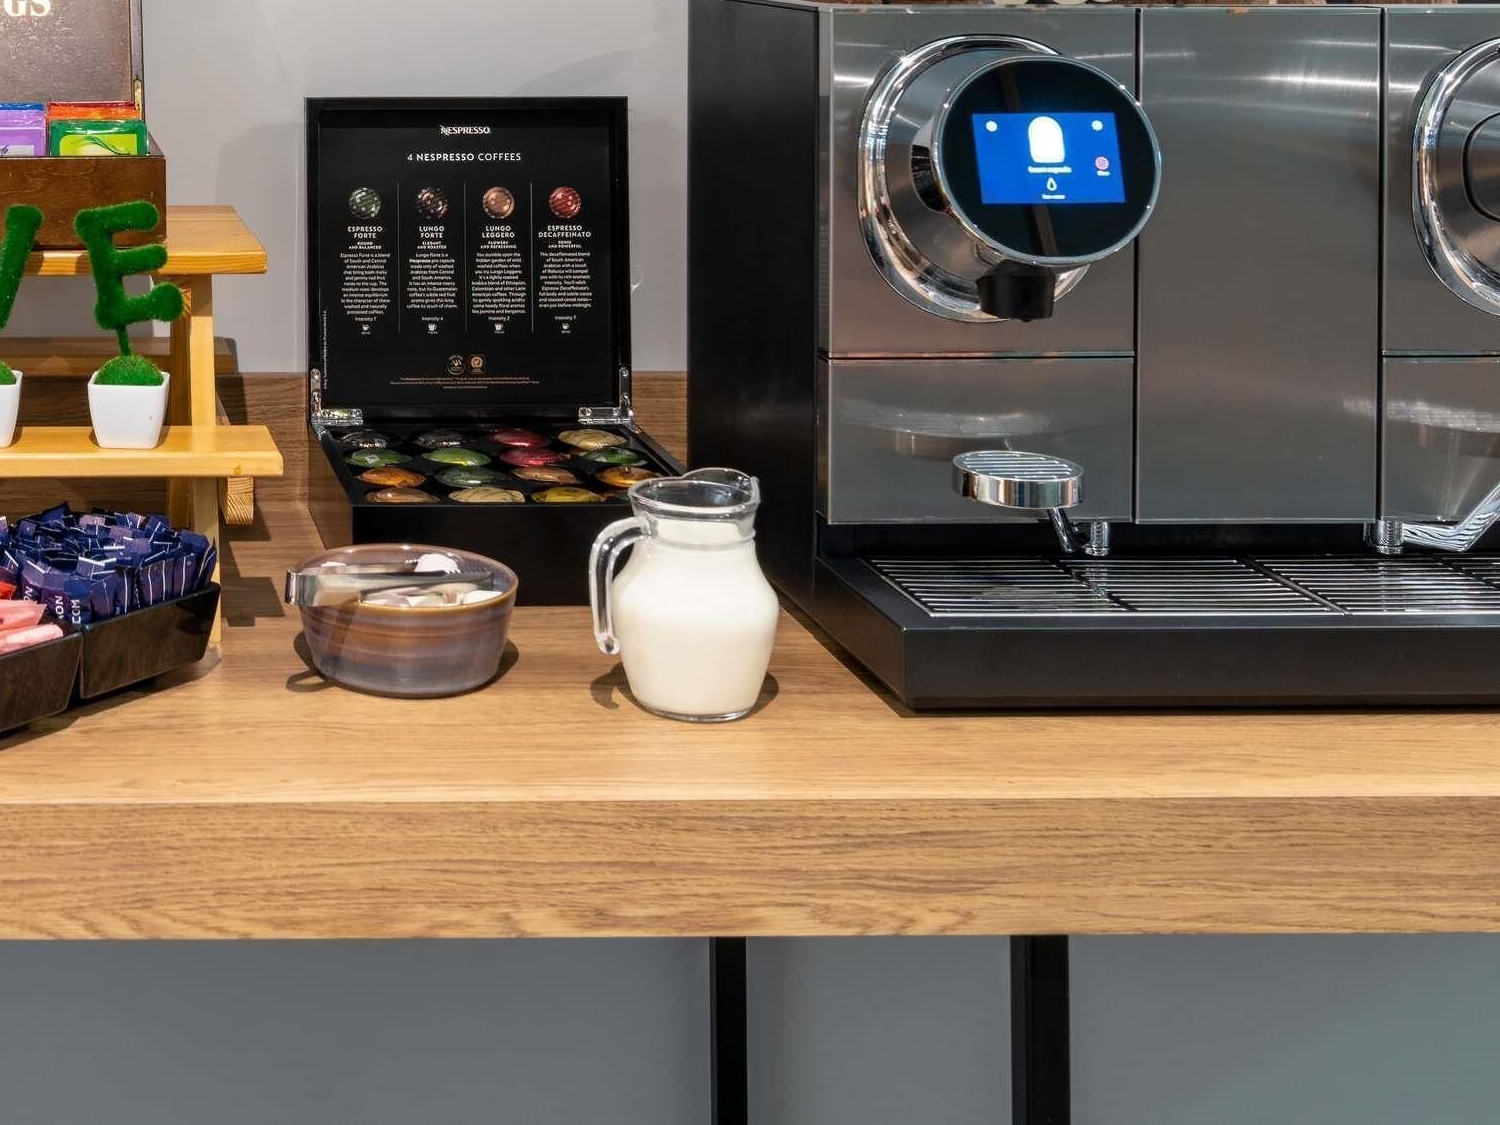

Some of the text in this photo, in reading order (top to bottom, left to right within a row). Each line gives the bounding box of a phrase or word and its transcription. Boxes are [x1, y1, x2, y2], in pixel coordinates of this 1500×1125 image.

[439, 124, 492, 135] NESPRESSO
[416, 153, 474, 162] NESPRESSO
[478, 152, 521, 161] COFFEES
